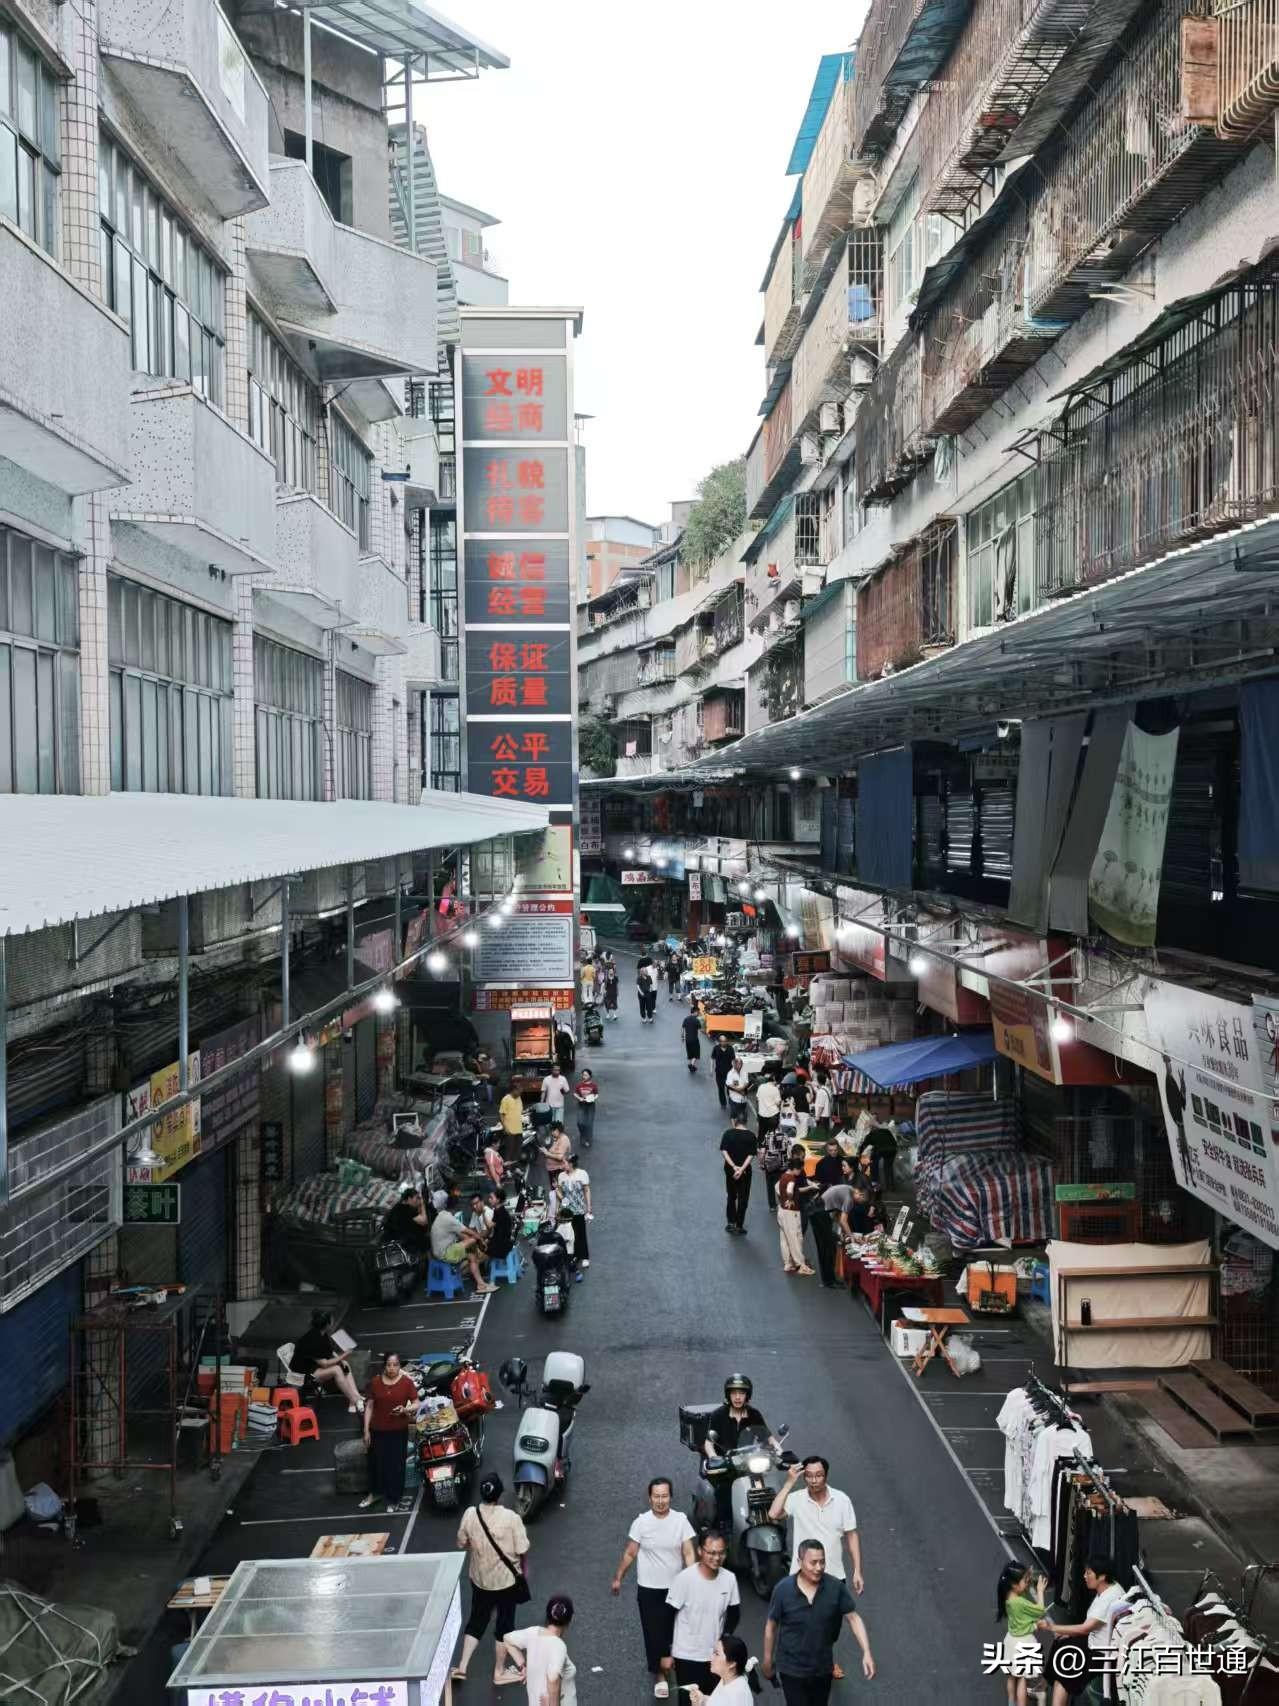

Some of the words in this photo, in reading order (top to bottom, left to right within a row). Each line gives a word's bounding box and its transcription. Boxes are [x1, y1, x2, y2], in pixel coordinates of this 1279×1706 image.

[484, 368, 544, 397] 文明
[487, 586, 546, 615] 经营
[488, 642, 549, 672] 保证
[489, 677, 549, 706] 质量
[491, 732, 549, 762] 公平
[491, 767, 550, 796] 交易
